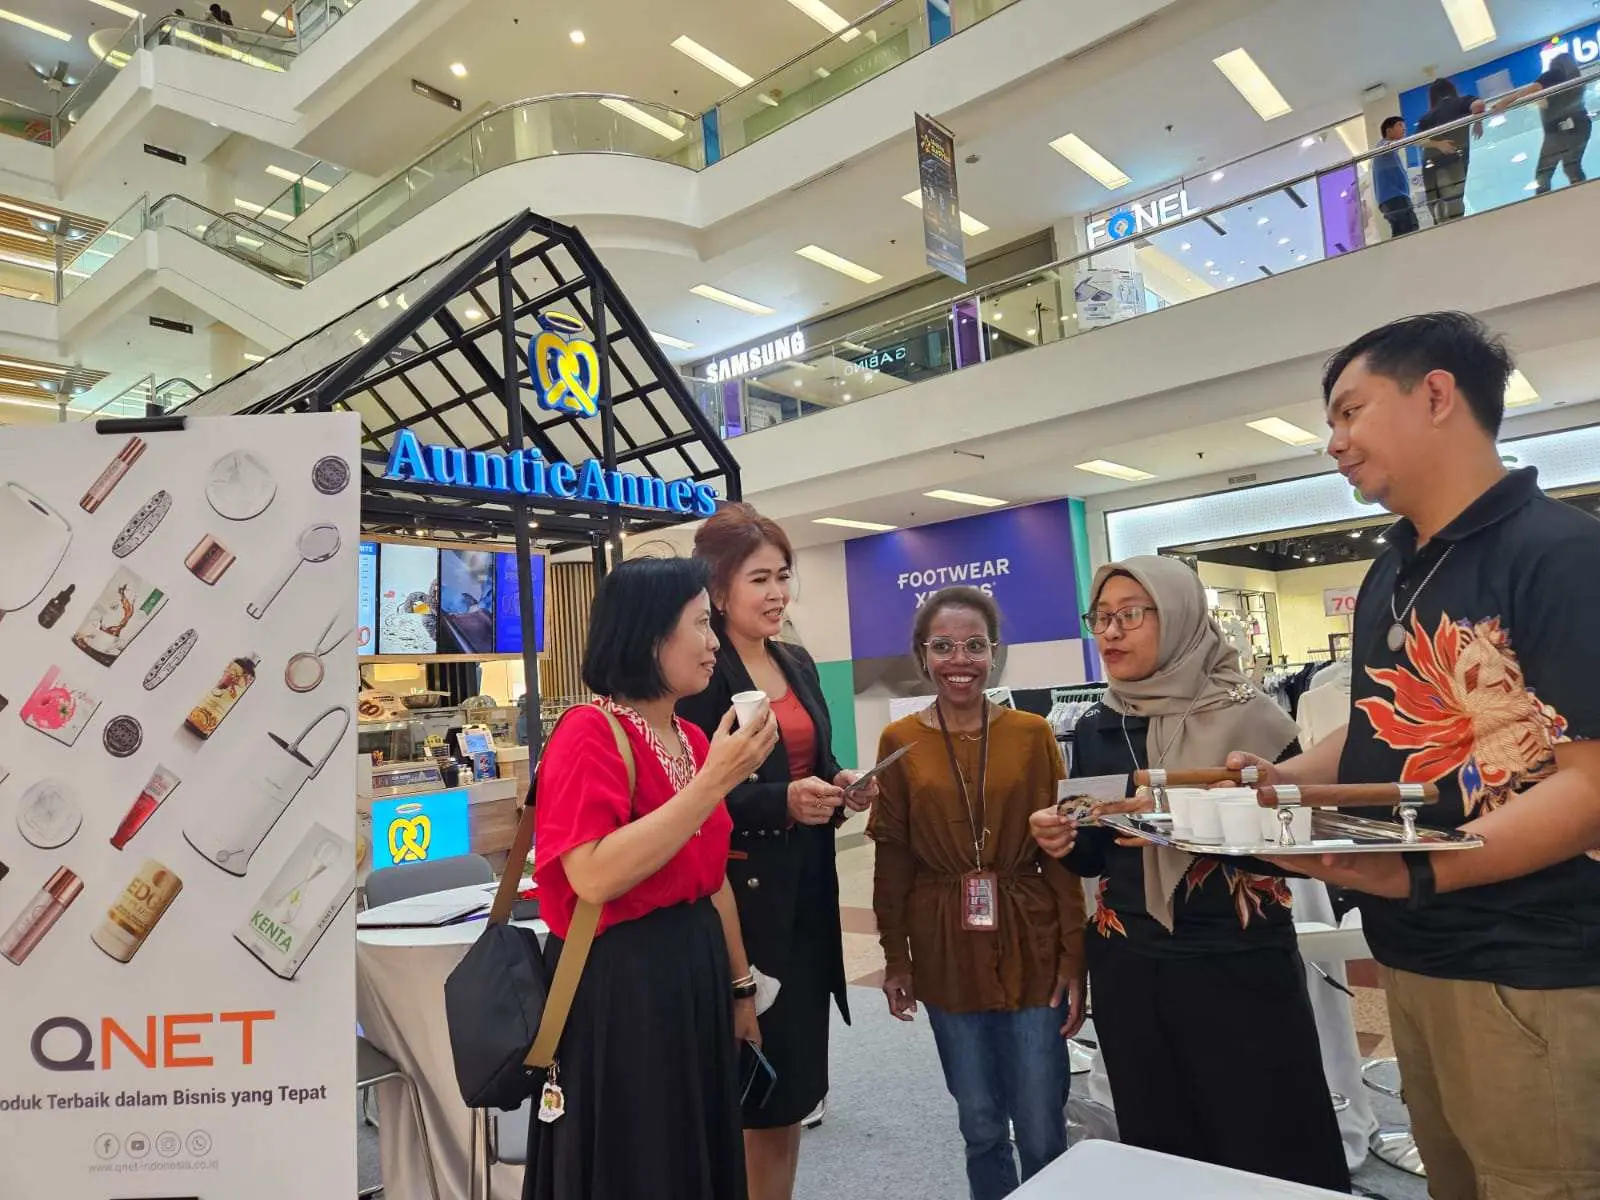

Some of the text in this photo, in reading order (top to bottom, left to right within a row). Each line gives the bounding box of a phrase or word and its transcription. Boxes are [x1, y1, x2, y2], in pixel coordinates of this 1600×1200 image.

[706, 330, 806, 384] SAMSUNG
[897, 558, 1010, 590] FOOTWEAR
[1331, 596, 1356, 611] 70
[250, 910, 293, 953] KENTA
[30, 1009, 277, 1072] QNET
[47, 1091, 110, 1110] Terbaik
[115, 1090, 168, 1108] dalam
[173, 1087, 227, 1106] Bisnis
[231, 1088, 273, 1108] yang
[278, 1084, 327, 1105] Tepat
